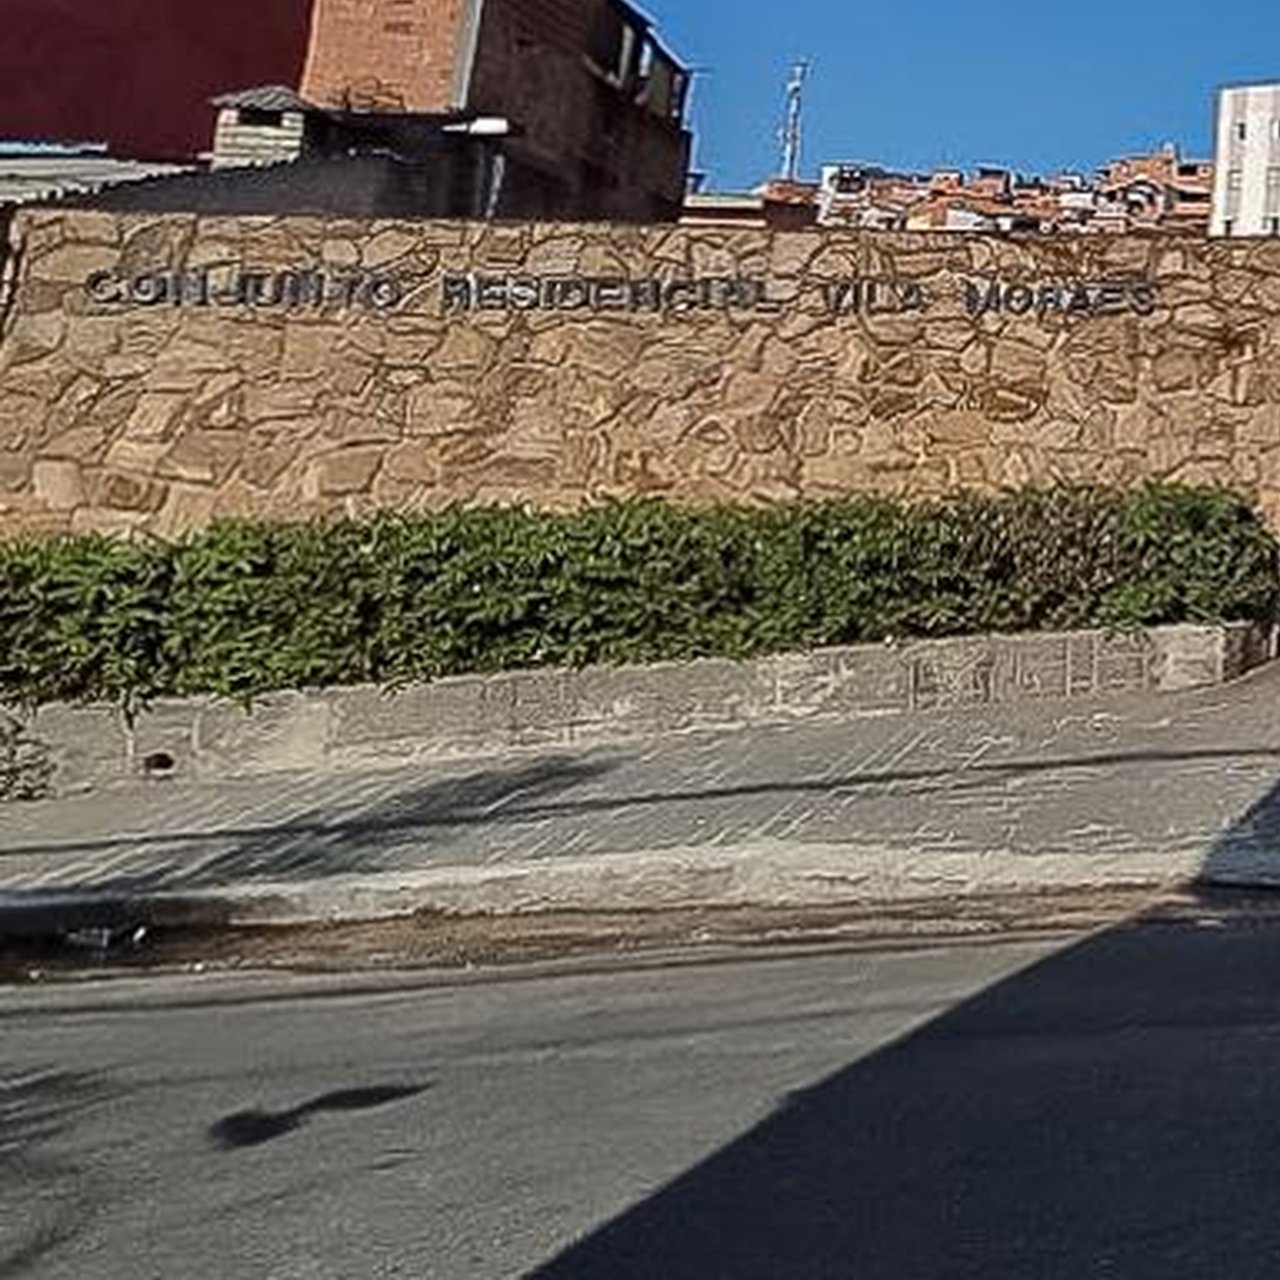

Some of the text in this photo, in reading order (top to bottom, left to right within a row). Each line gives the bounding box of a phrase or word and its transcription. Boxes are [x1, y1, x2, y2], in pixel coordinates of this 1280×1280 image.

[86, 269, 1156, 315] CONJUNTO RESIDENCIAL VILA MORAES
